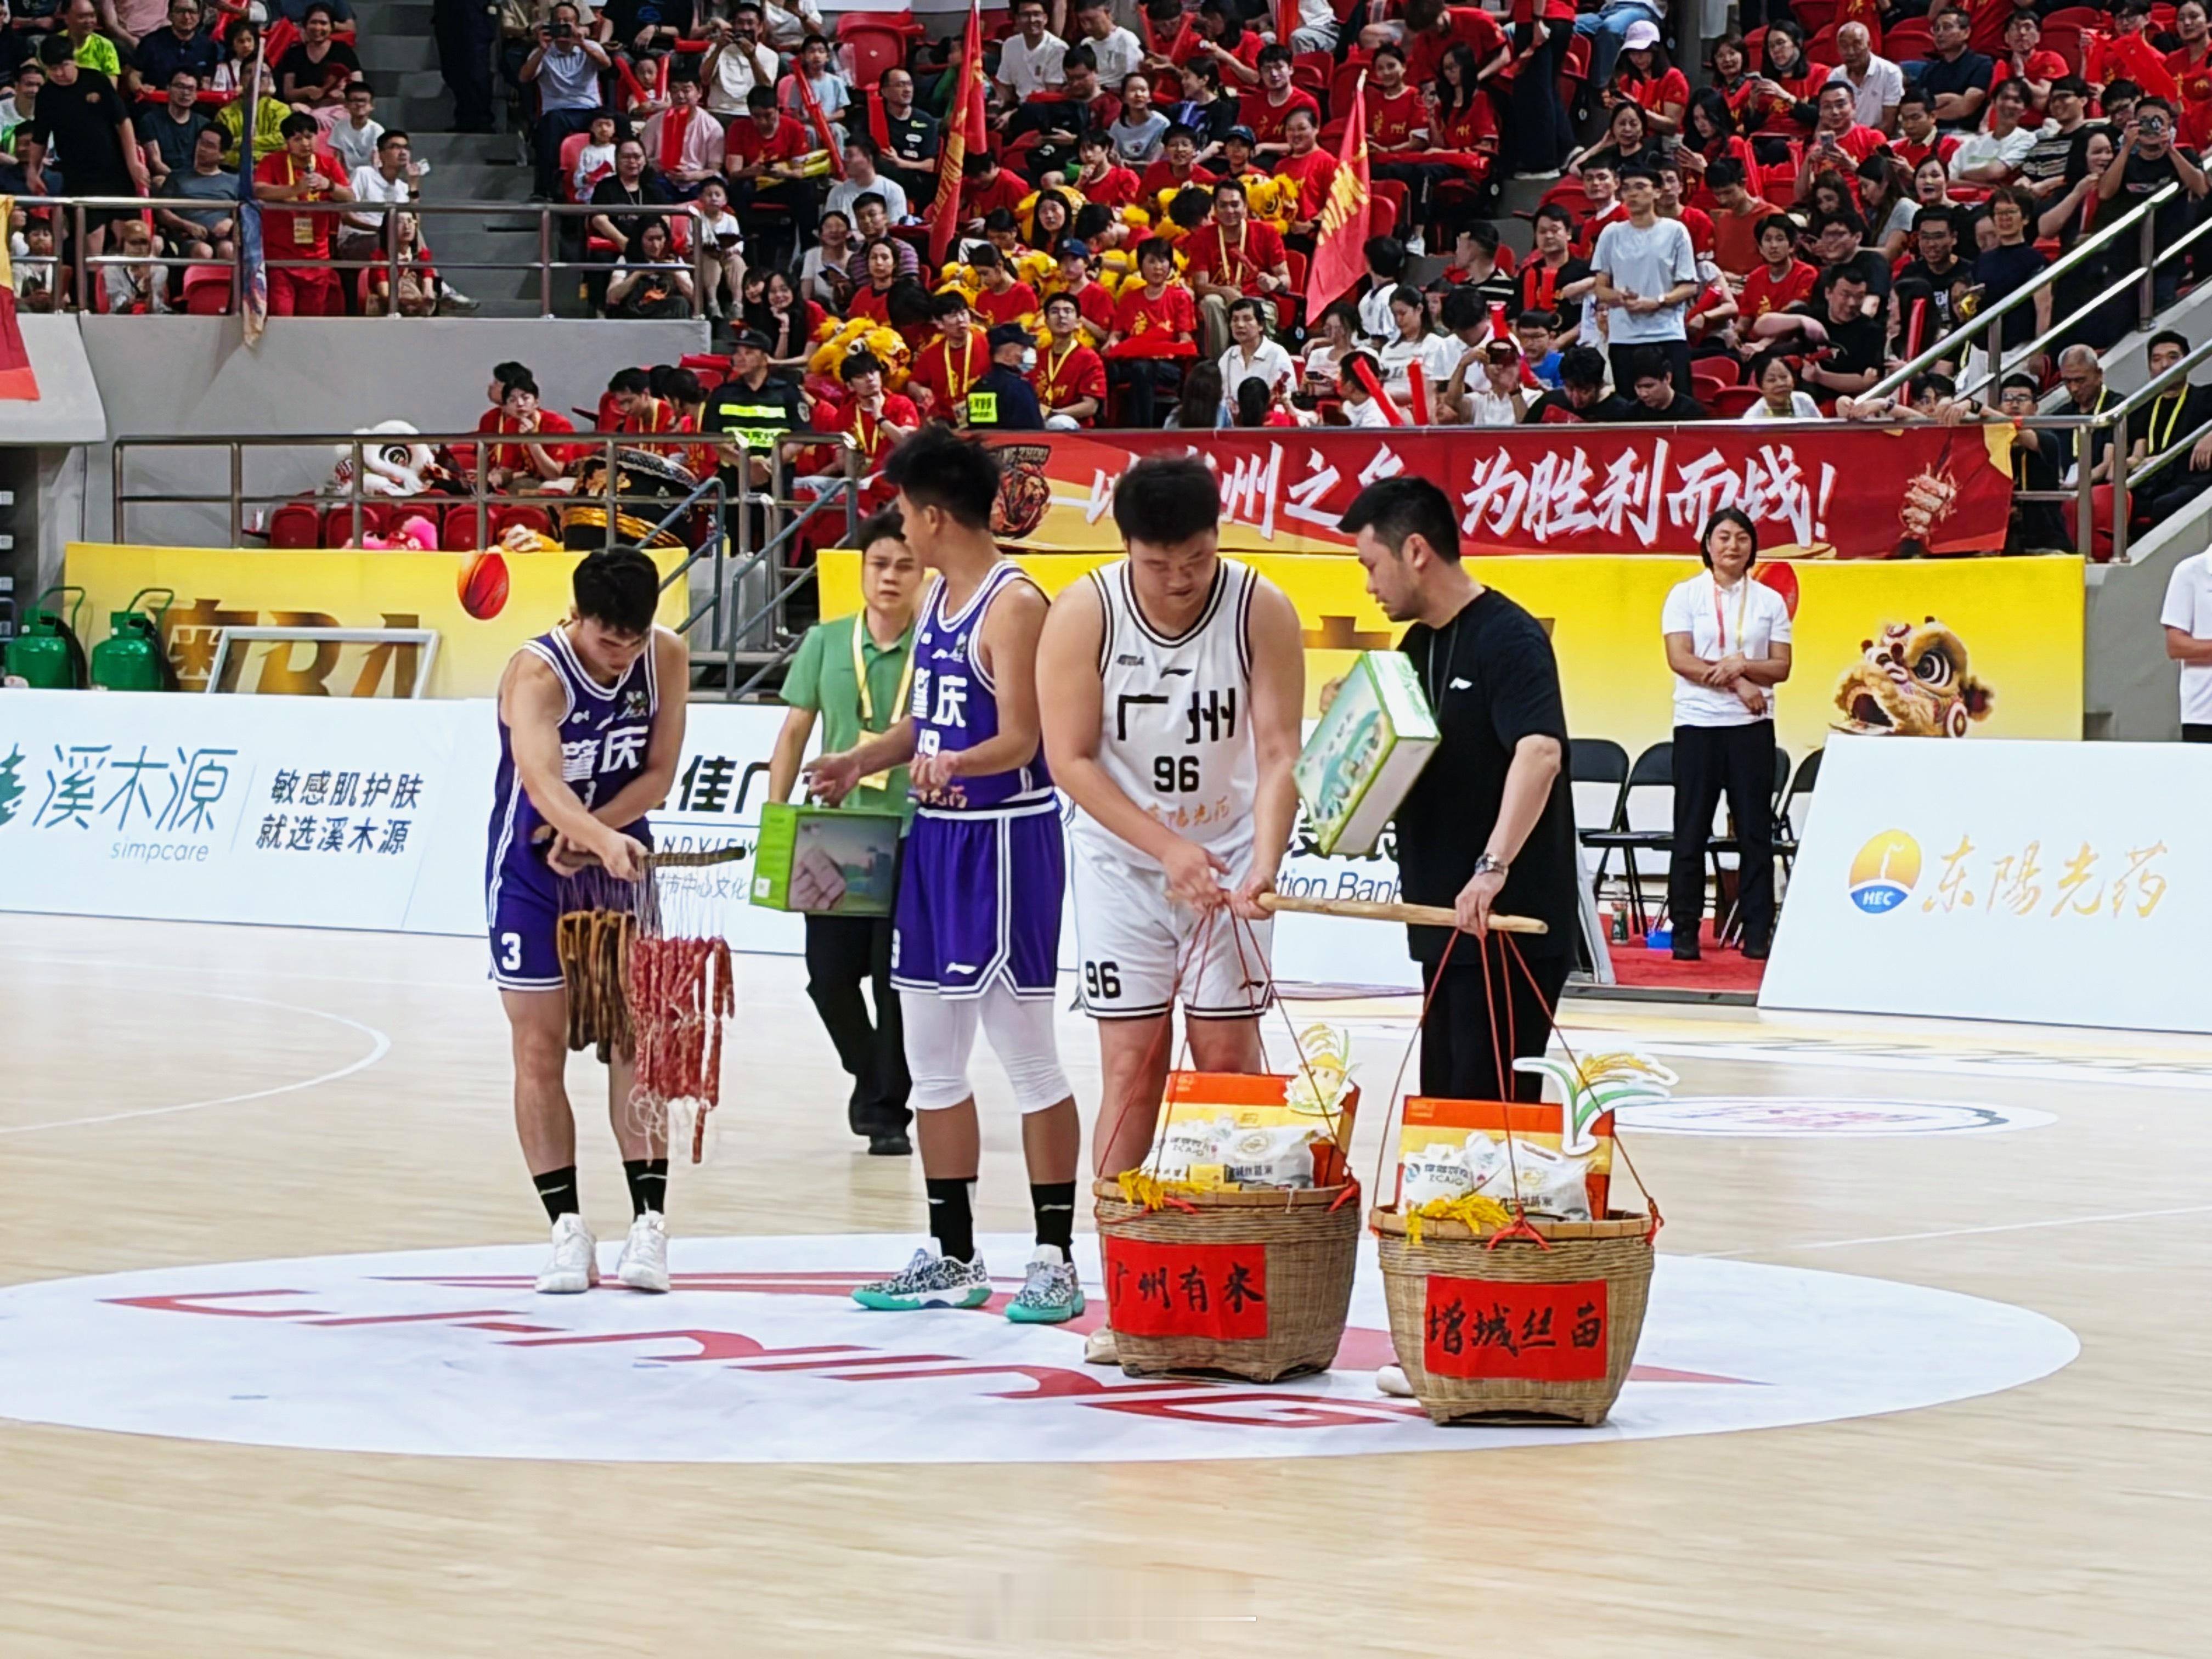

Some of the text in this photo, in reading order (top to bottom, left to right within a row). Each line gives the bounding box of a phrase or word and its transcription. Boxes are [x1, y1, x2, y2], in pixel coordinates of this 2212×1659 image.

[1117, 687, 1236, 744] 广州
[561, 725, 649, 782] 肇庆
[31, 743, 239, 834] 溪木源
[271, 768, 424, 809] 敏感肌护肤
[1154, 755, 1200, 792] 96
[110, 836, 210, 864] simpcare
[256, 813, 412, 855] 就选溪木源
[1276, 868, 1328, 899] tion
[1862, 890, 1895, 907] HEC
[501, 932, 521, 970] 3
[1085, 961, 1121, 999] 96
